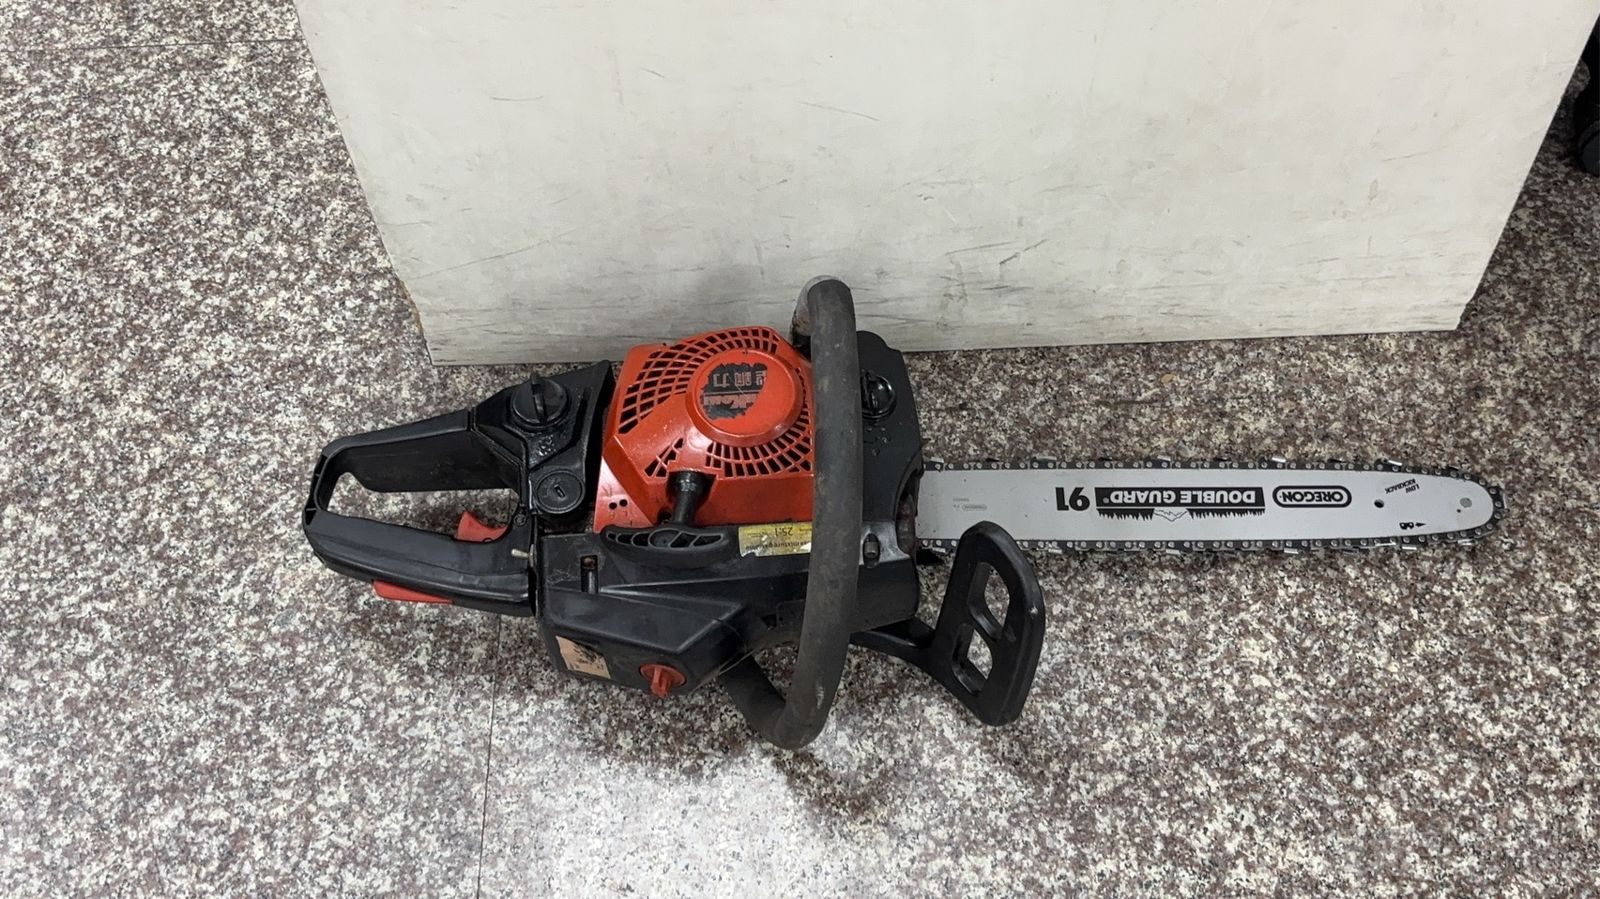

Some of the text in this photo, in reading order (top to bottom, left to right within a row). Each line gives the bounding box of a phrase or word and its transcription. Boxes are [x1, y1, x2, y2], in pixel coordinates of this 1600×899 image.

[1385, 478, 1416, 494] KICKBACK
[1405, 484, 1420, 493] LOW
[1055, 487, 1090, 511] 91
[1109, 490, 1256, 504] DOUBLE GUARD
[1281, 490, 1344, 503] OREGON
